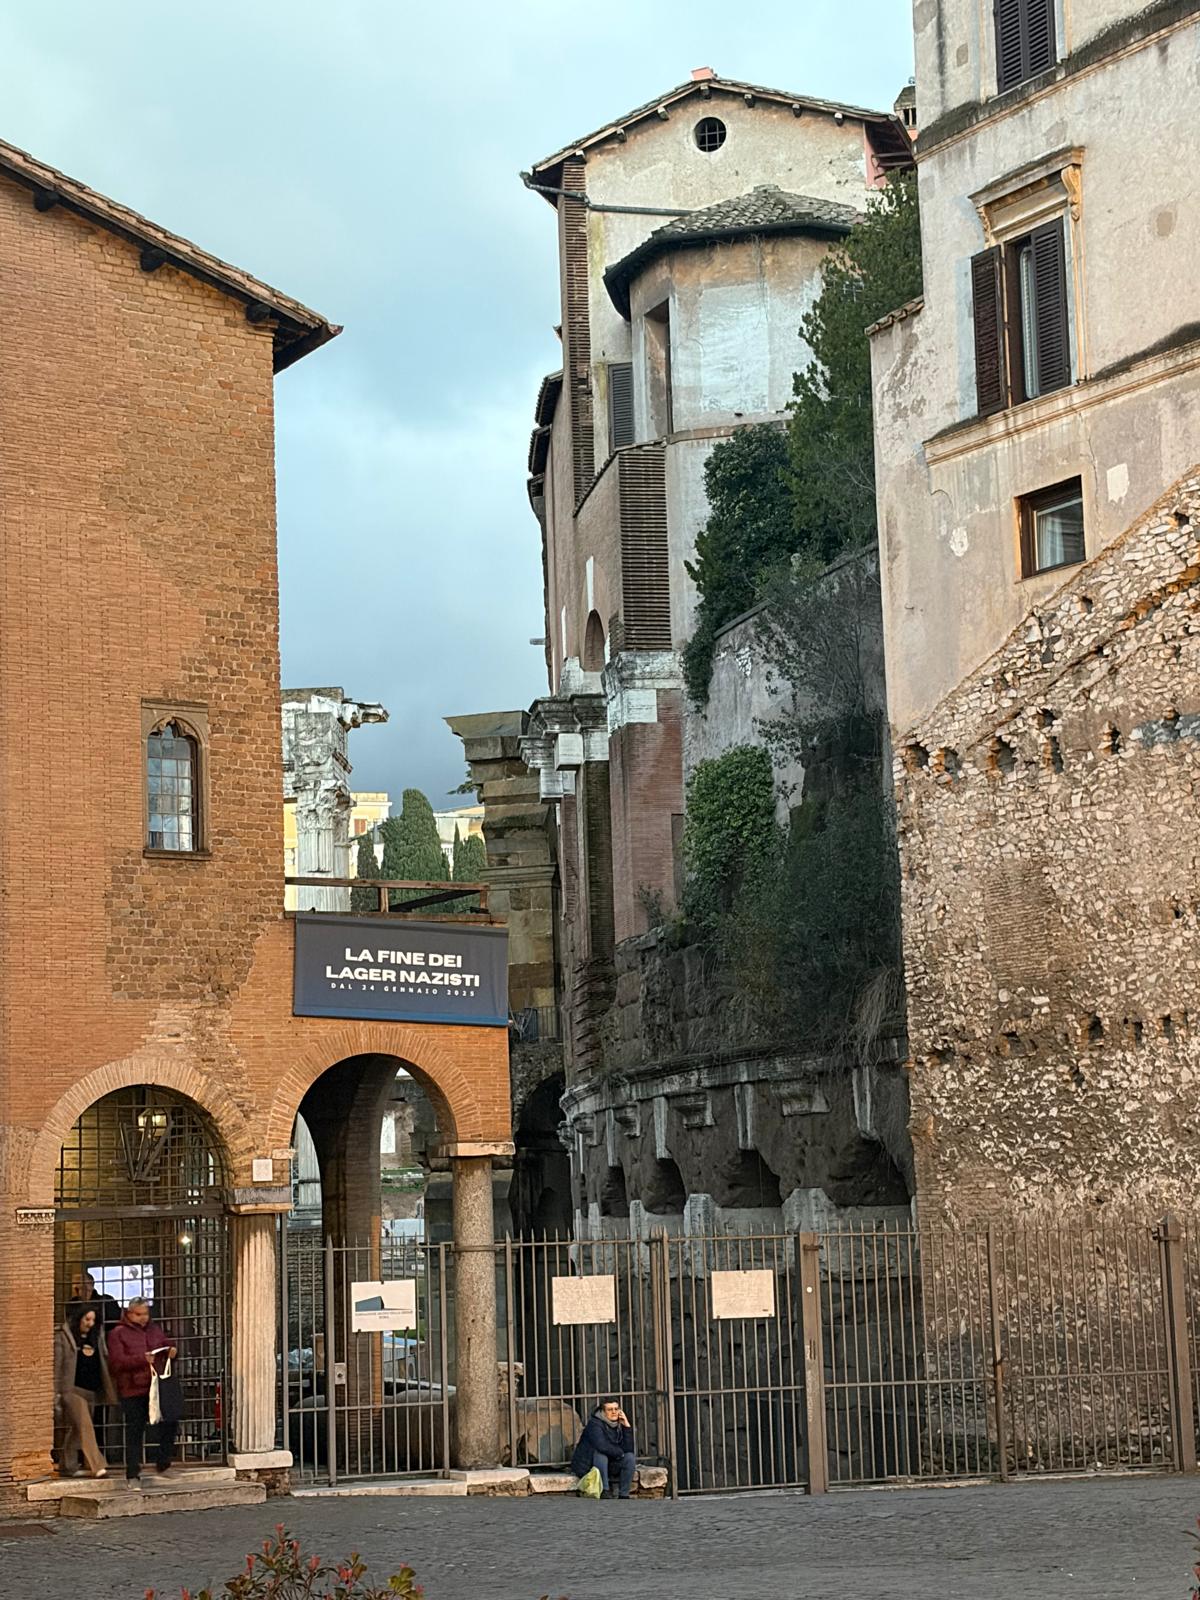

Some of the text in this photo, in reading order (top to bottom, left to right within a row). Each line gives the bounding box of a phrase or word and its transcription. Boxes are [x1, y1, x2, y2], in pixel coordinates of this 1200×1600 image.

[345, 948, 462, 968] LA FINE DEI
[326, 966, 480, 987] LAGER NAZISTI
[384, 986, 438, 995] GENNAIO
